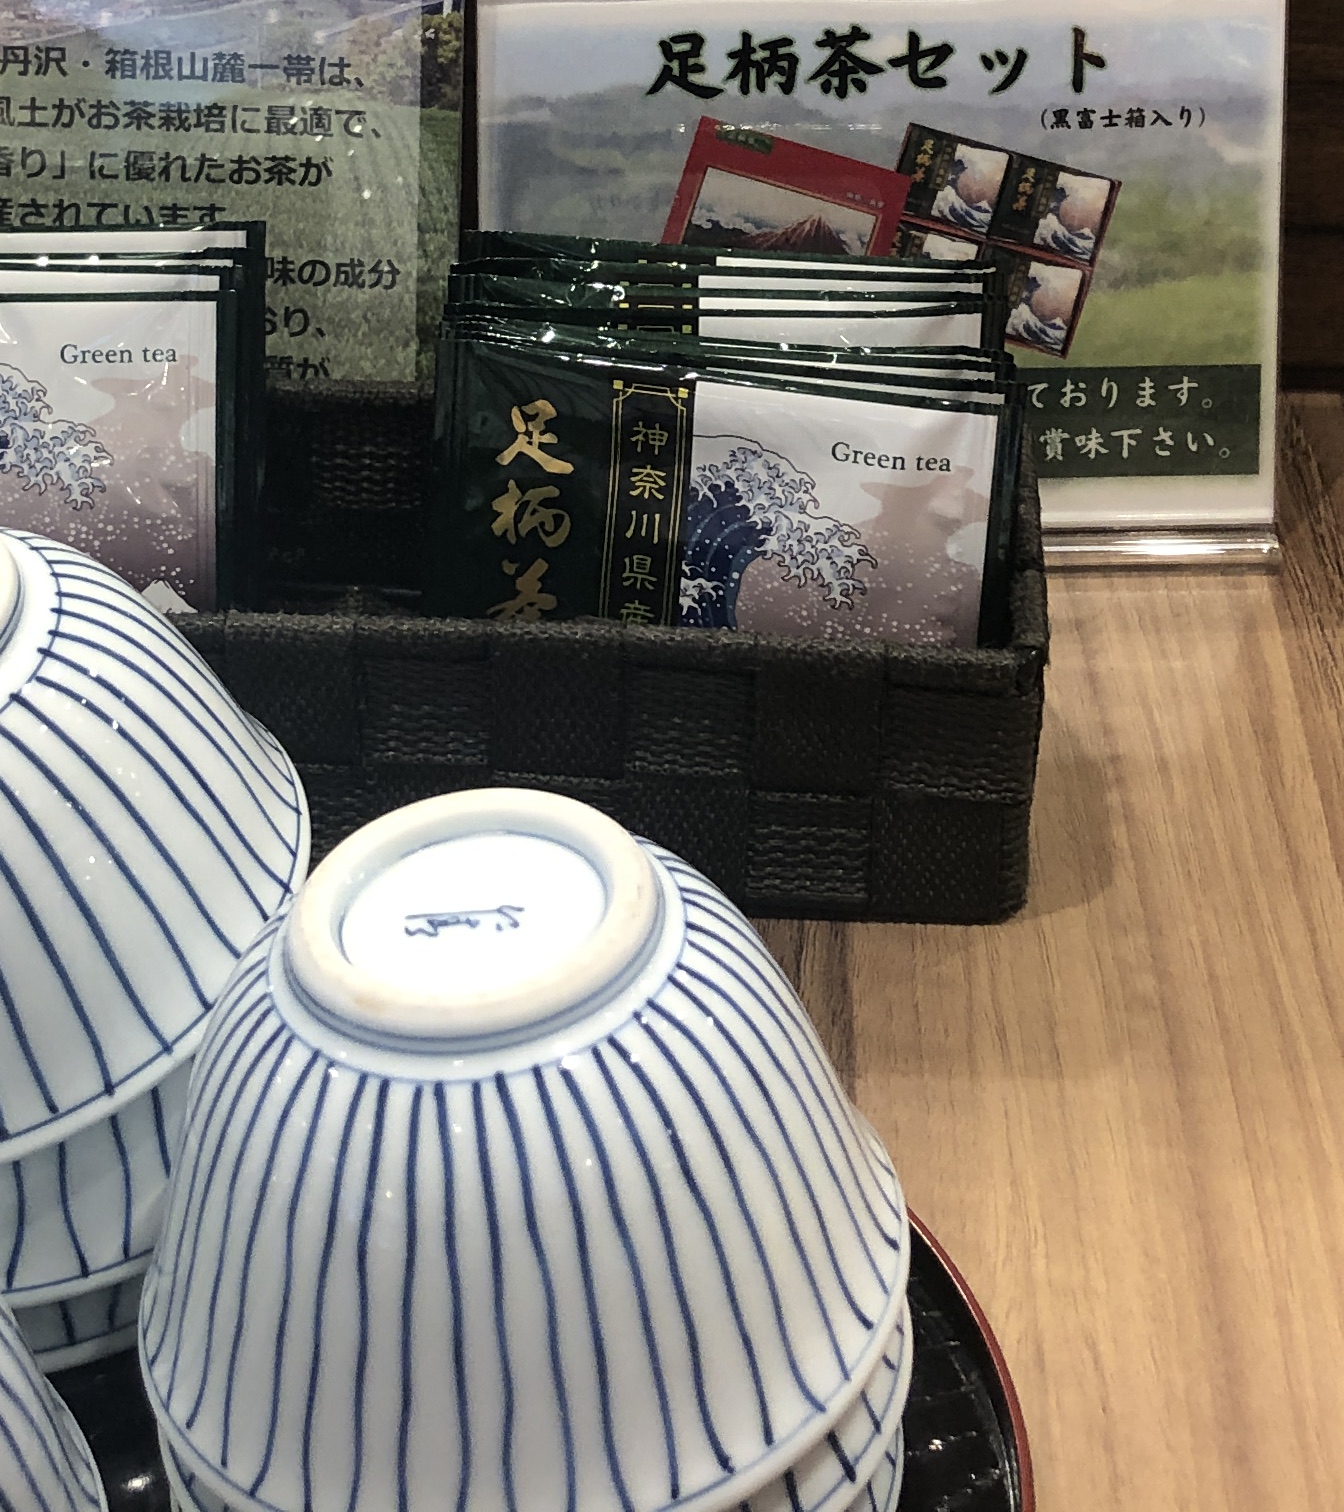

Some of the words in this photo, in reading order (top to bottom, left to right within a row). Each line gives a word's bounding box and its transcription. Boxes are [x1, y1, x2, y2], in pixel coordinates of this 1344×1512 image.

[646, 24, 1109, 100] 足柄茶セット
[60, 343, 133, 366] Green
[141, 345, 177, 365] tea
[830, 441, 906, 472] Green
[916, 453, 953, 473] tea
[1039, 426, 1231, 462] 賞味下さい。
